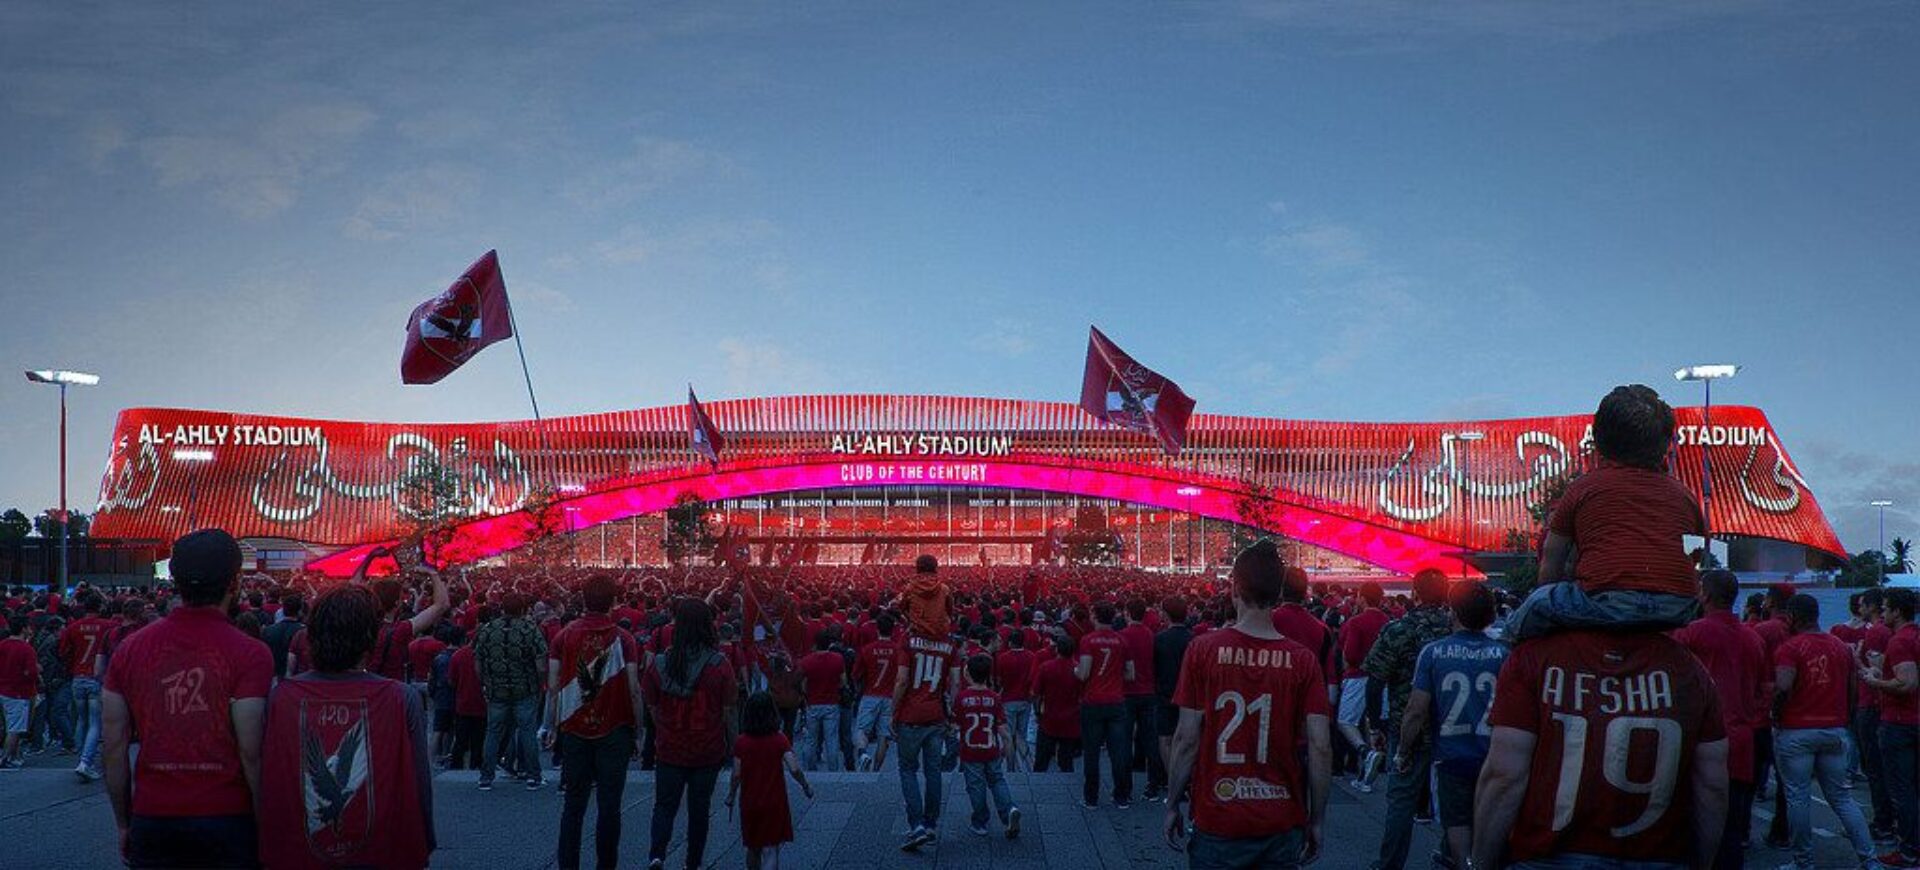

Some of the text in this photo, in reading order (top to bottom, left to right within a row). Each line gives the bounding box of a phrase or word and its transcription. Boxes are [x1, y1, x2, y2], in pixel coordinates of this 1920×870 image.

[139, 423, 321, 447] AL-AHLY STADIUM
[832, 434, 1009, 457] AL-AHLY STADIUM
[1678, 426, 1766, 446] STADIUM
[841, 463, 986, 482] CLUB OF THE CENTURY
[80, 634, 97, 664] 7
[1098, 648, 1111, 676] 7
[1217, 646, 1293, 669] MALOUL
[873, 659, 889, 689] 7
[912, 652, 944, 693] 14
[1440, 671, 1497, 736] 22
[1542, 666, 1673, 714] AFSHA
[965, 713, 994, 750] 23
[1214, 690, 1272, 764] 21
[1552, 712, 1682, 838] 19
